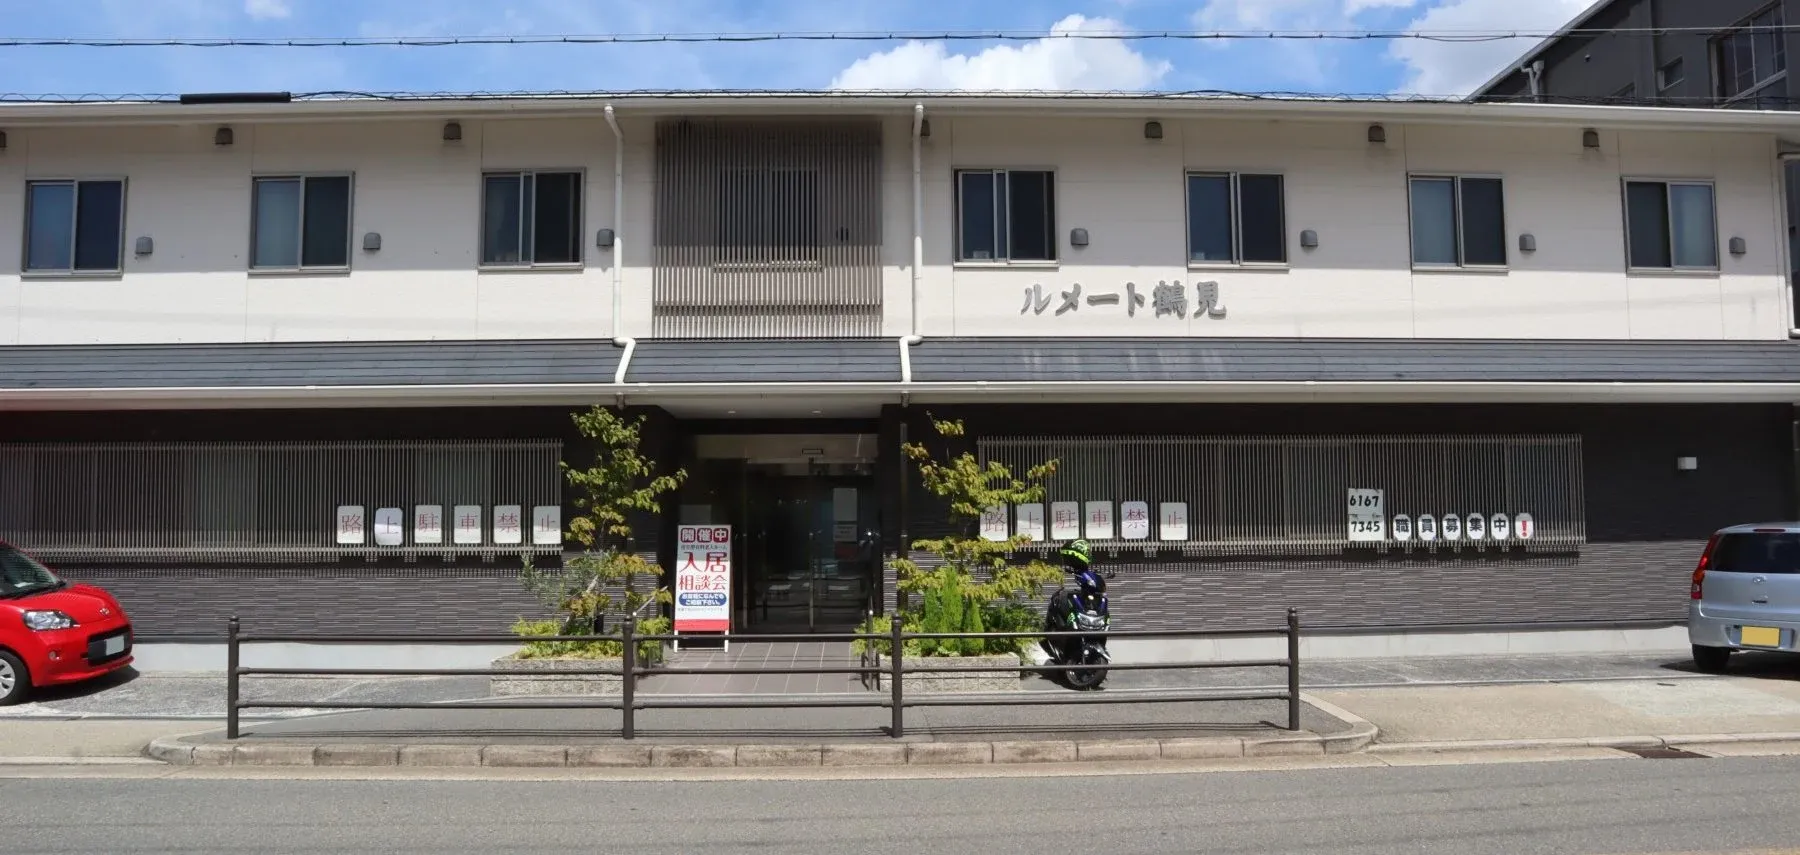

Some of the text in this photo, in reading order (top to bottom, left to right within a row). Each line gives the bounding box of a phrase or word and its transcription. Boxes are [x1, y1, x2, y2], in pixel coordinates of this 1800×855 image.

[1021, 280, 1227, 320] ルメート鶴見
[1350, 495, 1379, 507] 6167
[341, 512, 556, 535] 路上駐車禁止
[984, 507, 1184, 533] 路上駐車禁止
[1351, 521, 1380, 532] 7345
[682, 528, 728, 542] 開催中
[680, 551, 728, 572] 入居
[679, 574, 727, 590] 相談会
